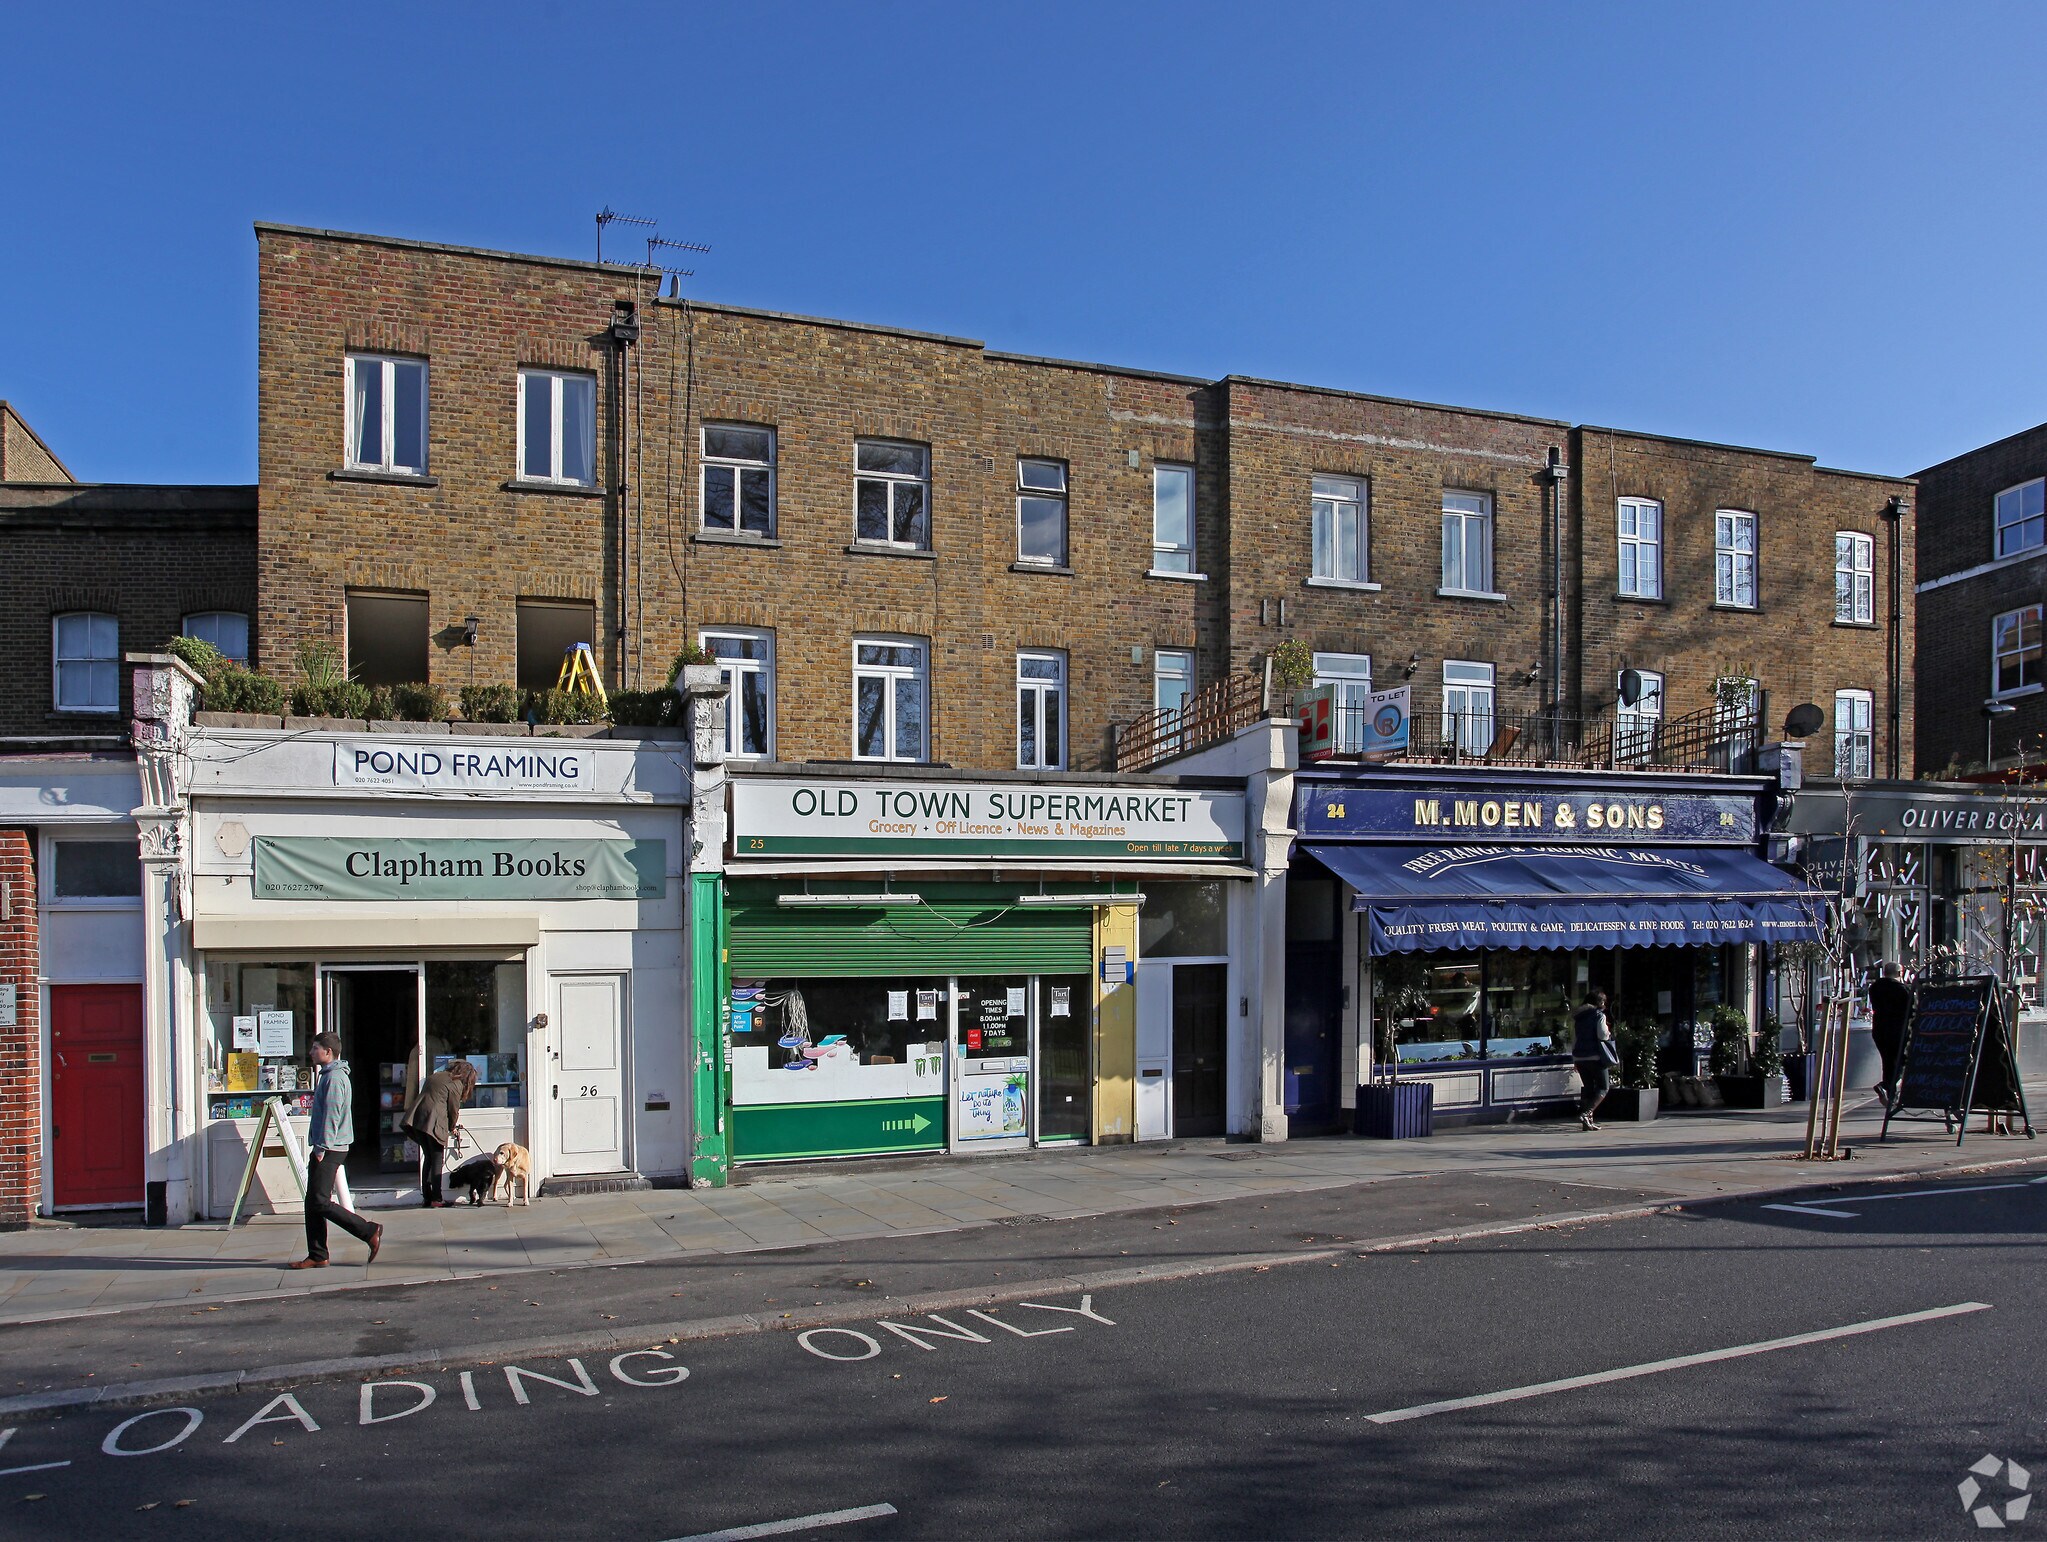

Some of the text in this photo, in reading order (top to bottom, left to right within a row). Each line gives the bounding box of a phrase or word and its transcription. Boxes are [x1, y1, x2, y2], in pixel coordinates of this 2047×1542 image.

[1371, 690, 1406, 703] TO LET
[355, 750, 579, 779] POND FRAMING
[792, 788, 1192, 822] OLD TOWN SUPERMARKET
[1327, 804, 1346, 819] 24
[1414, 799, 1664, 829] M.MOEN & SONS
[1719, 812, 1734, 826] 24
[1902, 808, 1979, 829] OLIVER
[868, 819, 1126, 839] Grocery Off Licence News & Magazines
[265, 840, 276, 848] 26
[750, 839, 764, 849] 25
[1127, 842, 1233, 854] Open till late 7 days a week
[345, 851, 586, 885] Clapham Books
[1402, 851, 1447, 874] FREE
[265, 883, 324, 892] 020 7627 2797
[575, 884, 657, 892] shop@claphambooks.com
[1383, 924, 1425, 938] QUALITY
[1428, 922, 1460, 934] FRESH
[1462, 921, 1488, 933] MEAT,
[1491, 921, 1528, 932] POULTRY
[1530, 922, 1538, 932] &
[1540, 922, 1566, 933] GAME,
[1570, 921, 1627, 931] DELICATESSEN
[1629, 921, 1637, 931] &
[1639, 920, 1658, 930] FINE
[1660, 920, 1686, 931] FOODS.
[1691, 920, 1704, 930] Tel:
[1705, 920, 1719, 930] 020
[1720, 920, 1736, 929] 7622
[1738, 919, 1754, 929] 1624
[580, 1085, 598, 1097] 26
[797, 1294, 1117, 1361] ONLY
